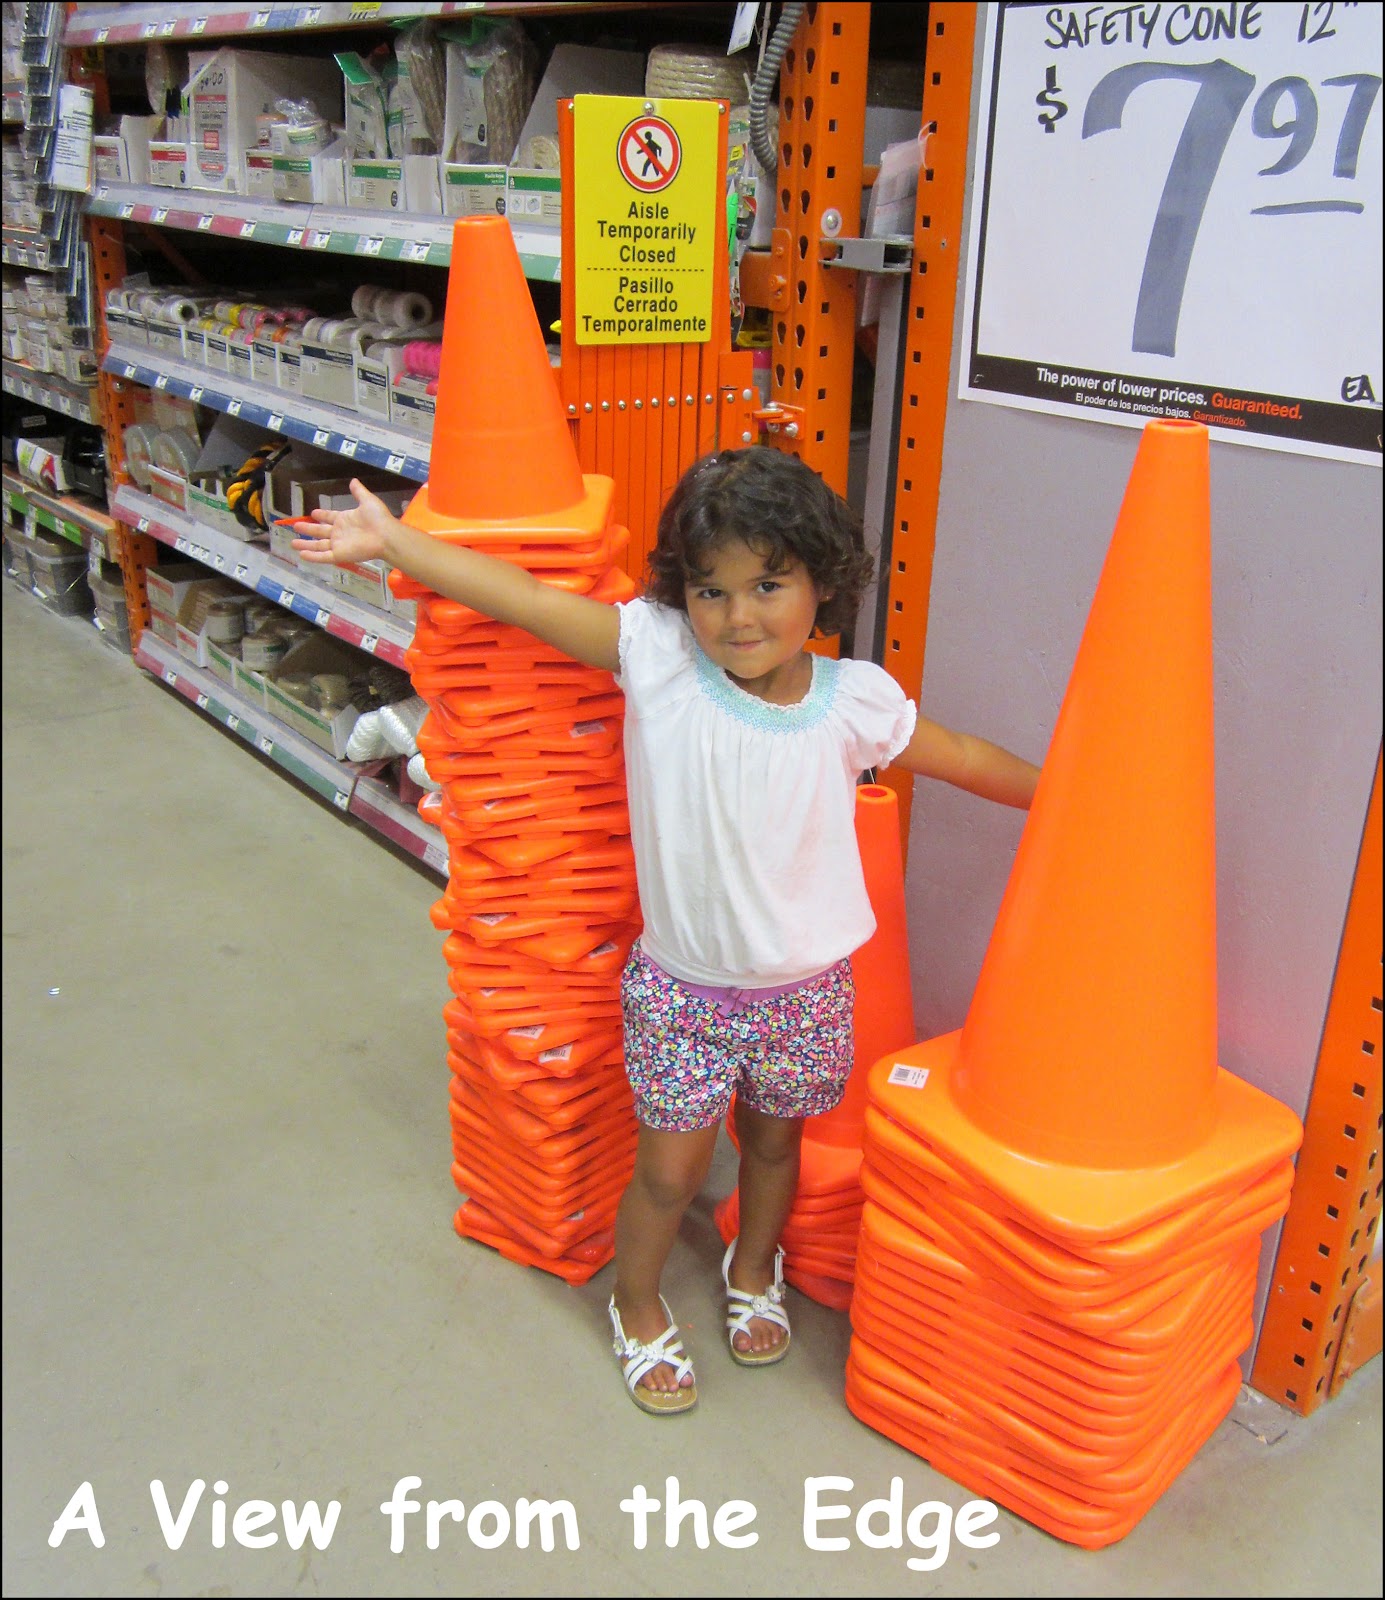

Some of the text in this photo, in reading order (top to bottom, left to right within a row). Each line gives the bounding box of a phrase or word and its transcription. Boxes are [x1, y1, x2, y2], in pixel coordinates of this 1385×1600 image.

[1045, 4, 1161, 49] SAFETY
[1165, 3, 1262, 45] CONE
[627, 202, 669, 219] Aisle
[1036, 59, 1382, 357] $ 7 97
[598, 221, 696, 244] Temporarily
[620, 245, 676, 263] Closed
[619, 277, 674, 293] Pasillo
[614, 296, 678, 312] Cerrado
[583, 316, 706, 336] Temporalmente
[1037, 367, 1303, 419] The power of lower prices. Guaranteed.
[1075, 393, 1247, 427] El poder de los precios bajos. Garantizado.
